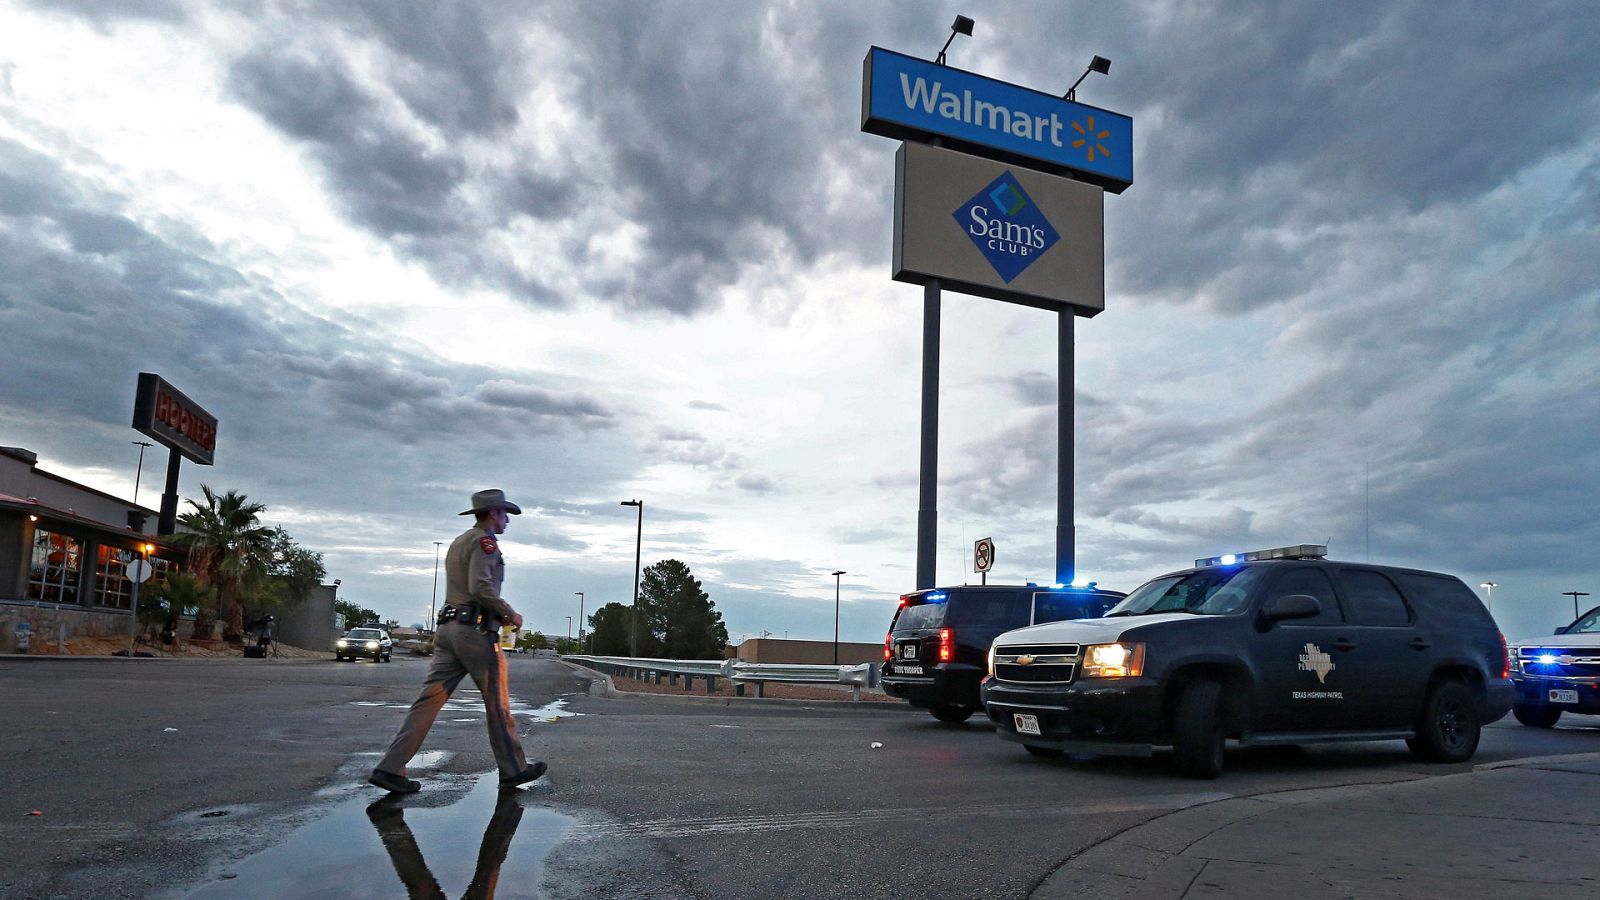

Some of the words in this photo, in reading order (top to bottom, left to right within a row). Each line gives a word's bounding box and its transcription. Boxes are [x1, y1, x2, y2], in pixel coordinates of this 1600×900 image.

[899, 72, 1063, 148] Walmart
[970, 205, 1045, 249] Sam's
[988, 239, 1028, 256] CLUB
[1292, 691, 1306, 699] TEXAS
[1307, 691, 1327, 699] HIGHWAY
[1327, 691, 1344, 699] PATROL
